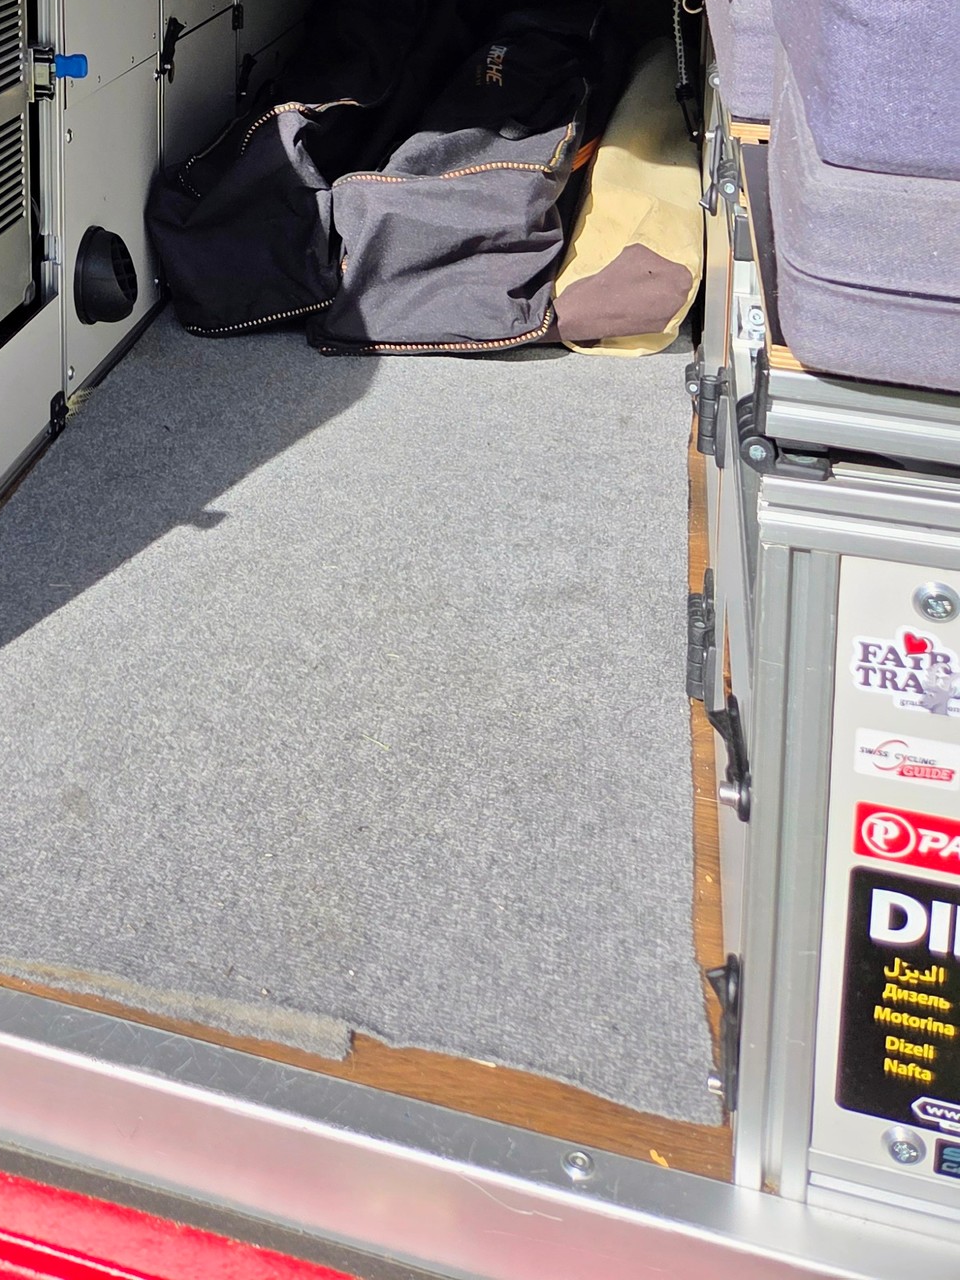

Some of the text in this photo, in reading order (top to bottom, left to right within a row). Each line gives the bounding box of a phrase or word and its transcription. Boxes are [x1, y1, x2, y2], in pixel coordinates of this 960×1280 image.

[858, 640, 954, 675] FAIR
[859, 746, 937, 766] SWISS CYCLING
[902, 765, 951, 780] GUIDE
[869, 887, 960, 957] DI
[882, 982, 952, 1010] Дизель
[874, 1005, 955, 1037] Motorina
[885, 1035, 935, 1061] Dizeli
[883, 1057, 933, 1082] Nafta
